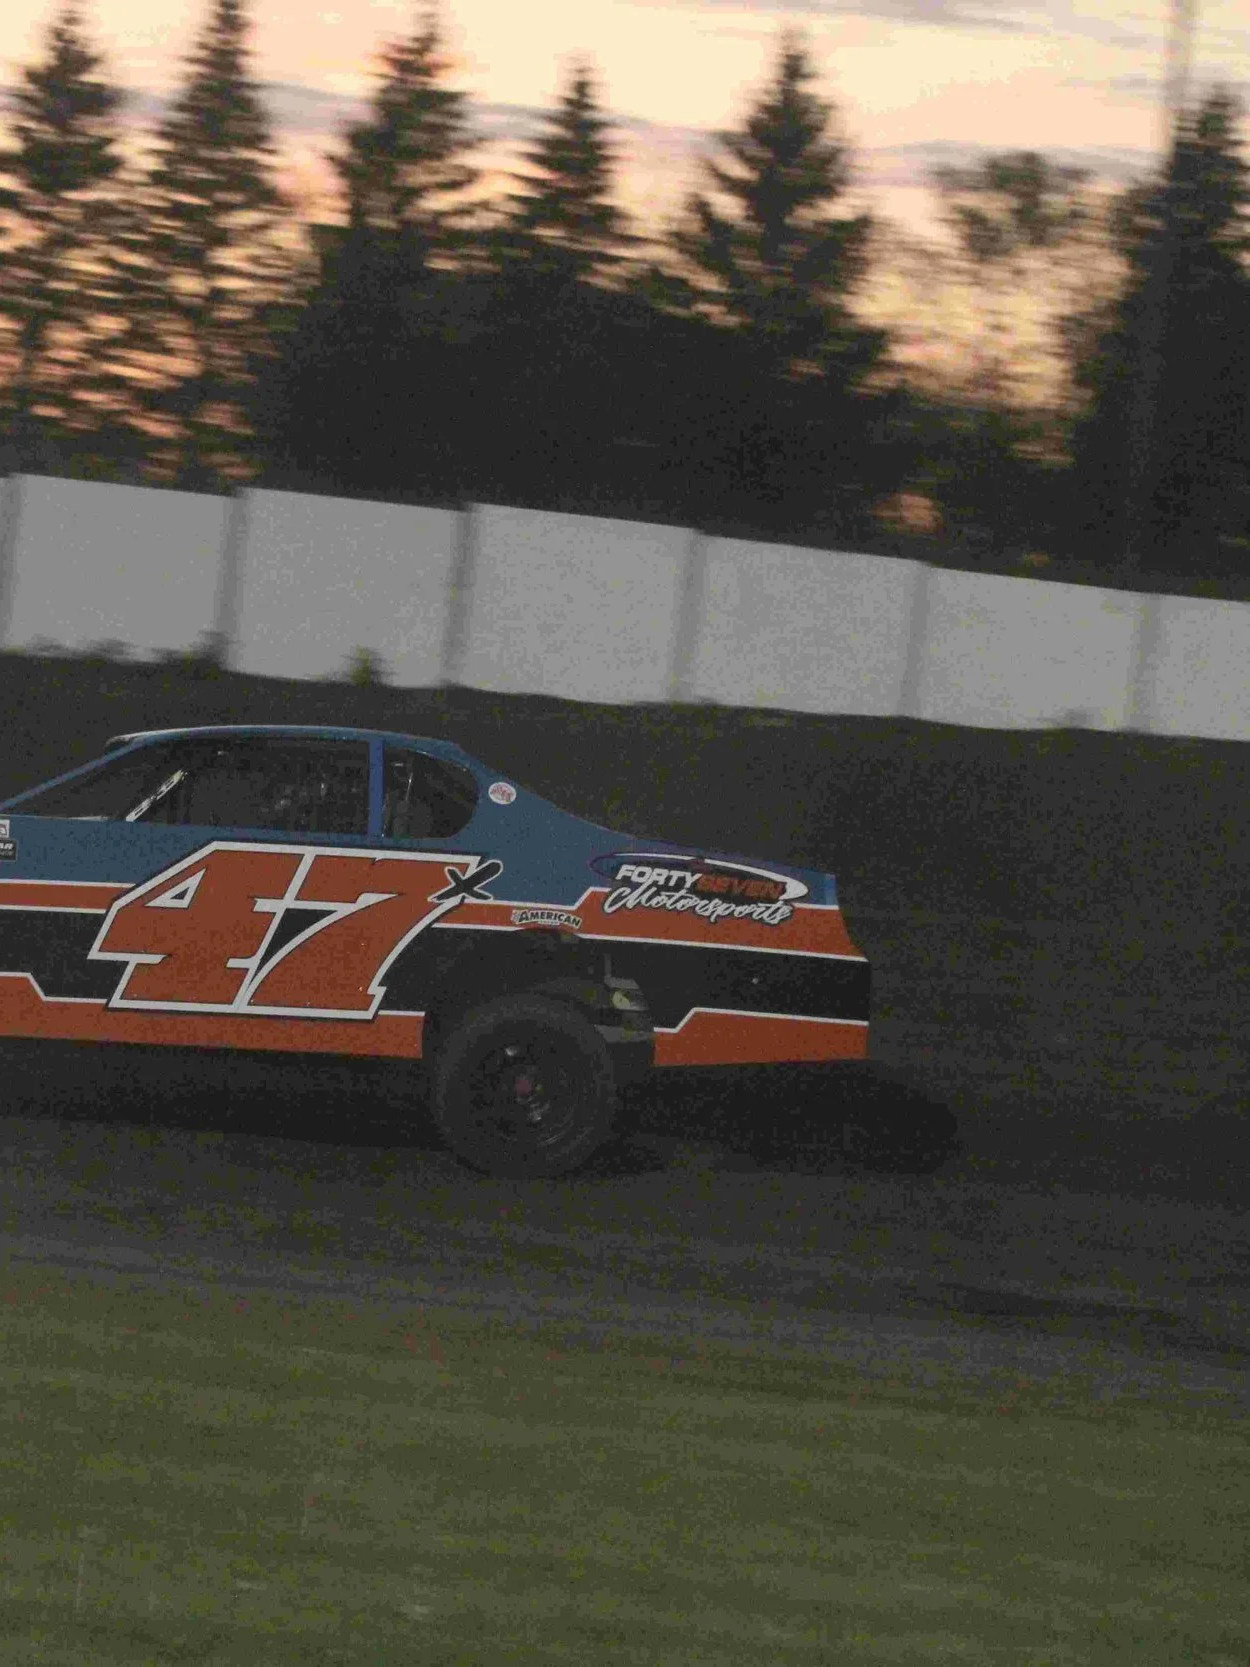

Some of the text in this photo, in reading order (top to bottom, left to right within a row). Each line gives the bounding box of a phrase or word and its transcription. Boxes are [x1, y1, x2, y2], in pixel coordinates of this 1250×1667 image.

[518, 911, 581, 927] AMERICAN
[602, 879, 794, 925] Motorsports
[86, 840, 482, 1020] 47
